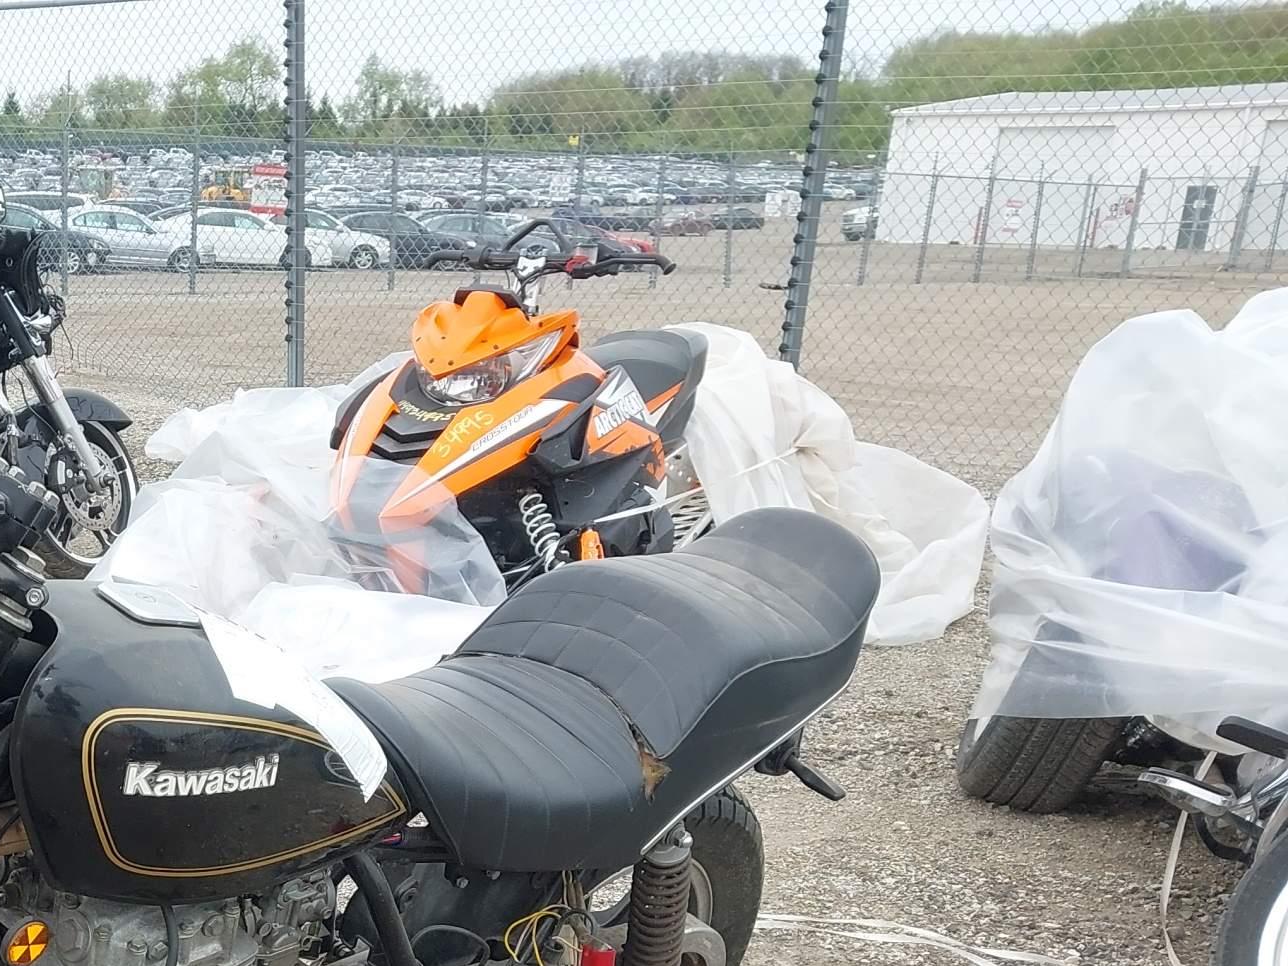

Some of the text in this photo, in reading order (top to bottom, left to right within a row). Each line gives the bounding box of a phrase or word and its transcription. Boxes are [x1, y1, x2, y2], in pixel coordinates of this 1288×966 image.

[433, 410, 494, 458] 34995
[472, 405, 533, 453] CROSSTOUR
[123, 753, 279, 797] Kawasaki
